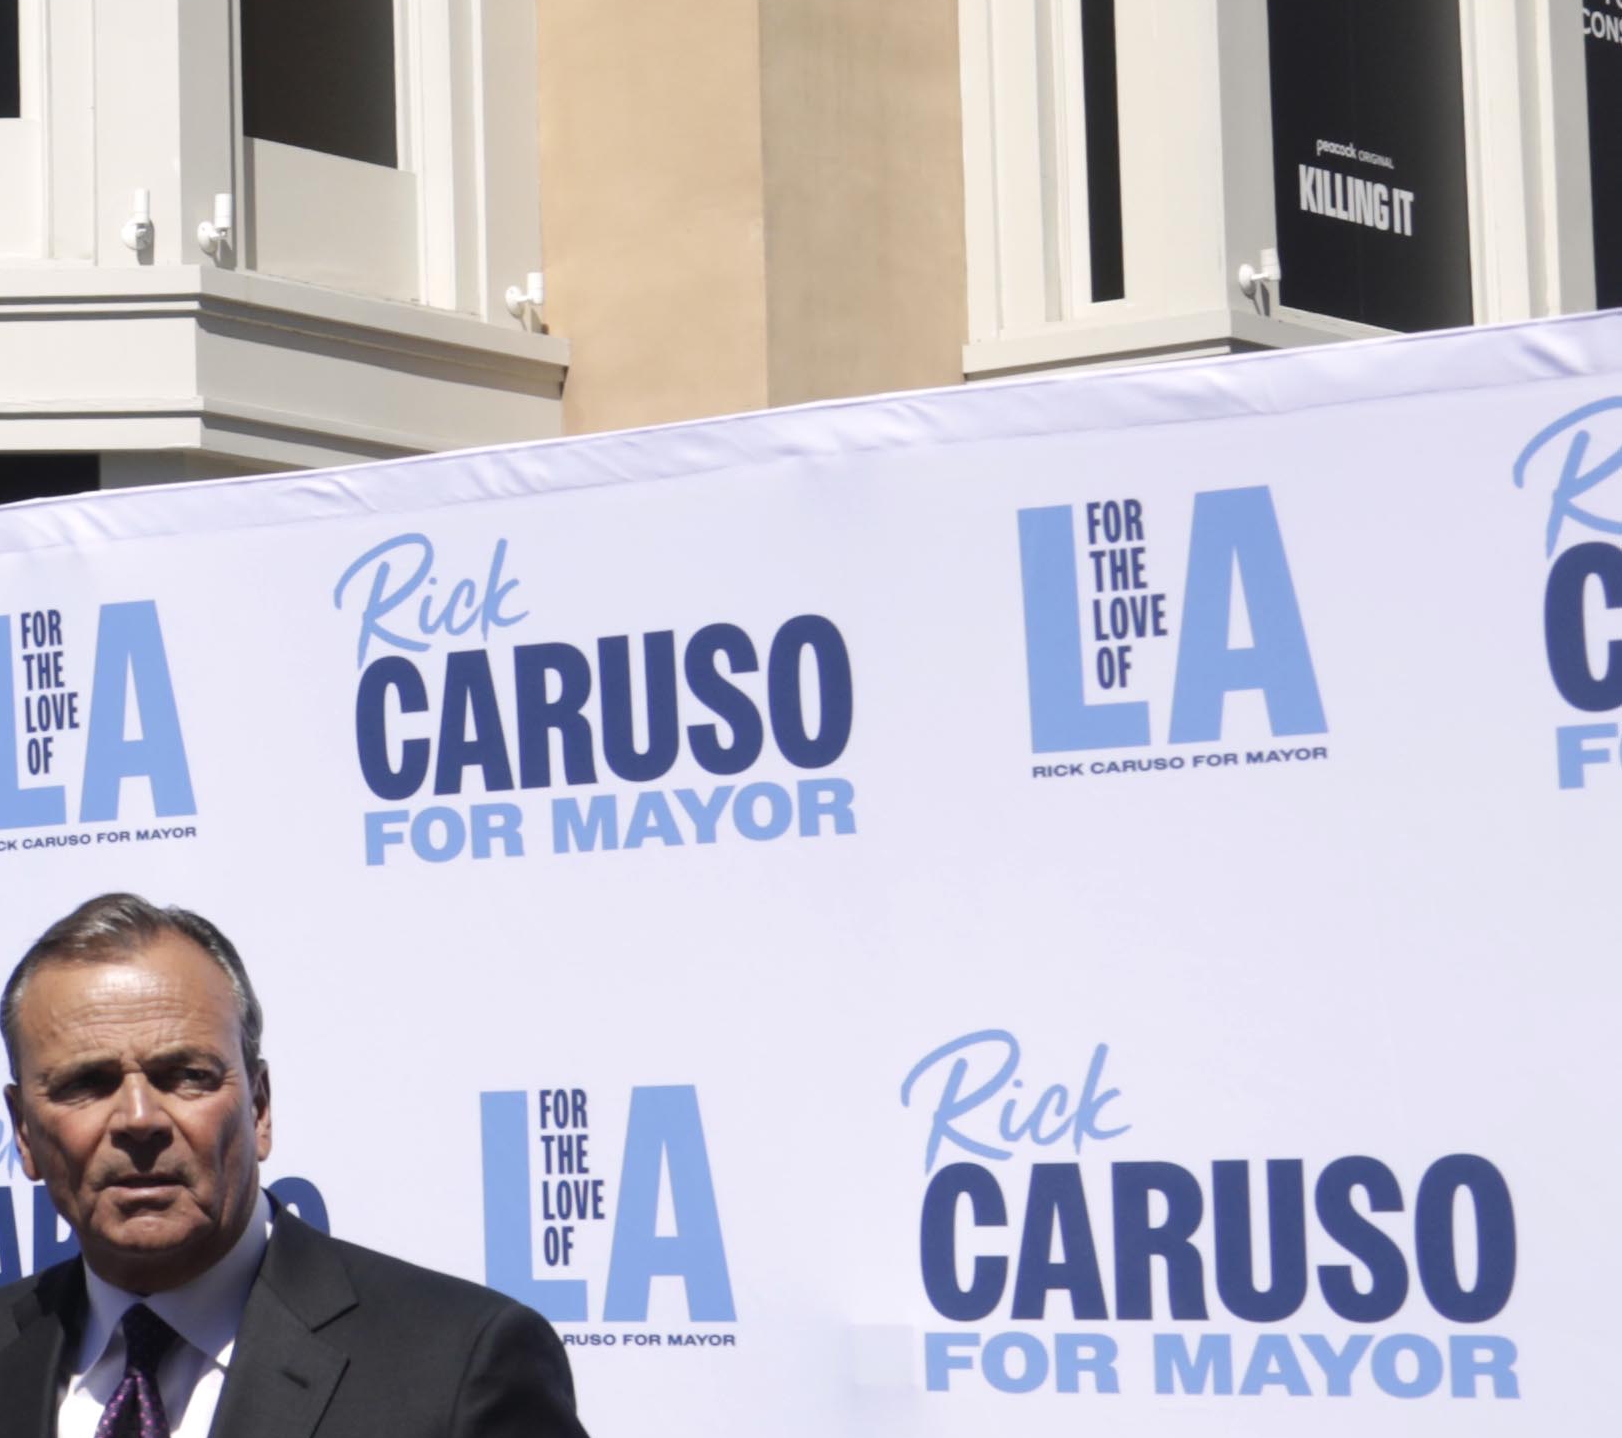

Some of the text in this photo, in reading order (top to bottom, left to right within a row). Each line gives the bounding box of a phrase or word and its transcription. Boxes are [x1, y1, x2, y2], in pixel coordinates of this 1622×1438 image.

[1299, 164, 1414, 236] KILLING IT
[1086, 499, 1145, 545] FOR
[1089, 548, 1147, 591] THE
[335, 532, 530, 668] Rick
[1016, 484, 1329, 755] LA
[1093, 594, 1167, 640] LOVE
[20, 608, 63, 650] FOR
[22, 651, 65, 692] THE
[1096, 648, 1133, 689] OF
[24, 692, 79, 733] LOVE
[354, 612, 854, 802] CARUSO
[27, 736, 54, 776] OF
[1031, 745, 1328, 779] RICK CARUSO FOR MAYOR
[21, 833, 91, 851] CARUSO
[95, 829, 131, 845] FOR
[135, 826, 197, 843] MAYOR
[363, 777, 858, 866] FOR MAYOR
[538, 1089, 588, 1129] FOR
[899, 1028, 1134, 1174] Rick
[539, 1135, 589, 1174] THE
[479, 1082, 738, 1324] LA
[542, 1180, 606, 1221] LOVE
[544, 1226, 575, 1268] OF
[919, 1153, 1519, 1324] CARUSO
[924, 1330, 1521, 1400] FOR MAYOR
